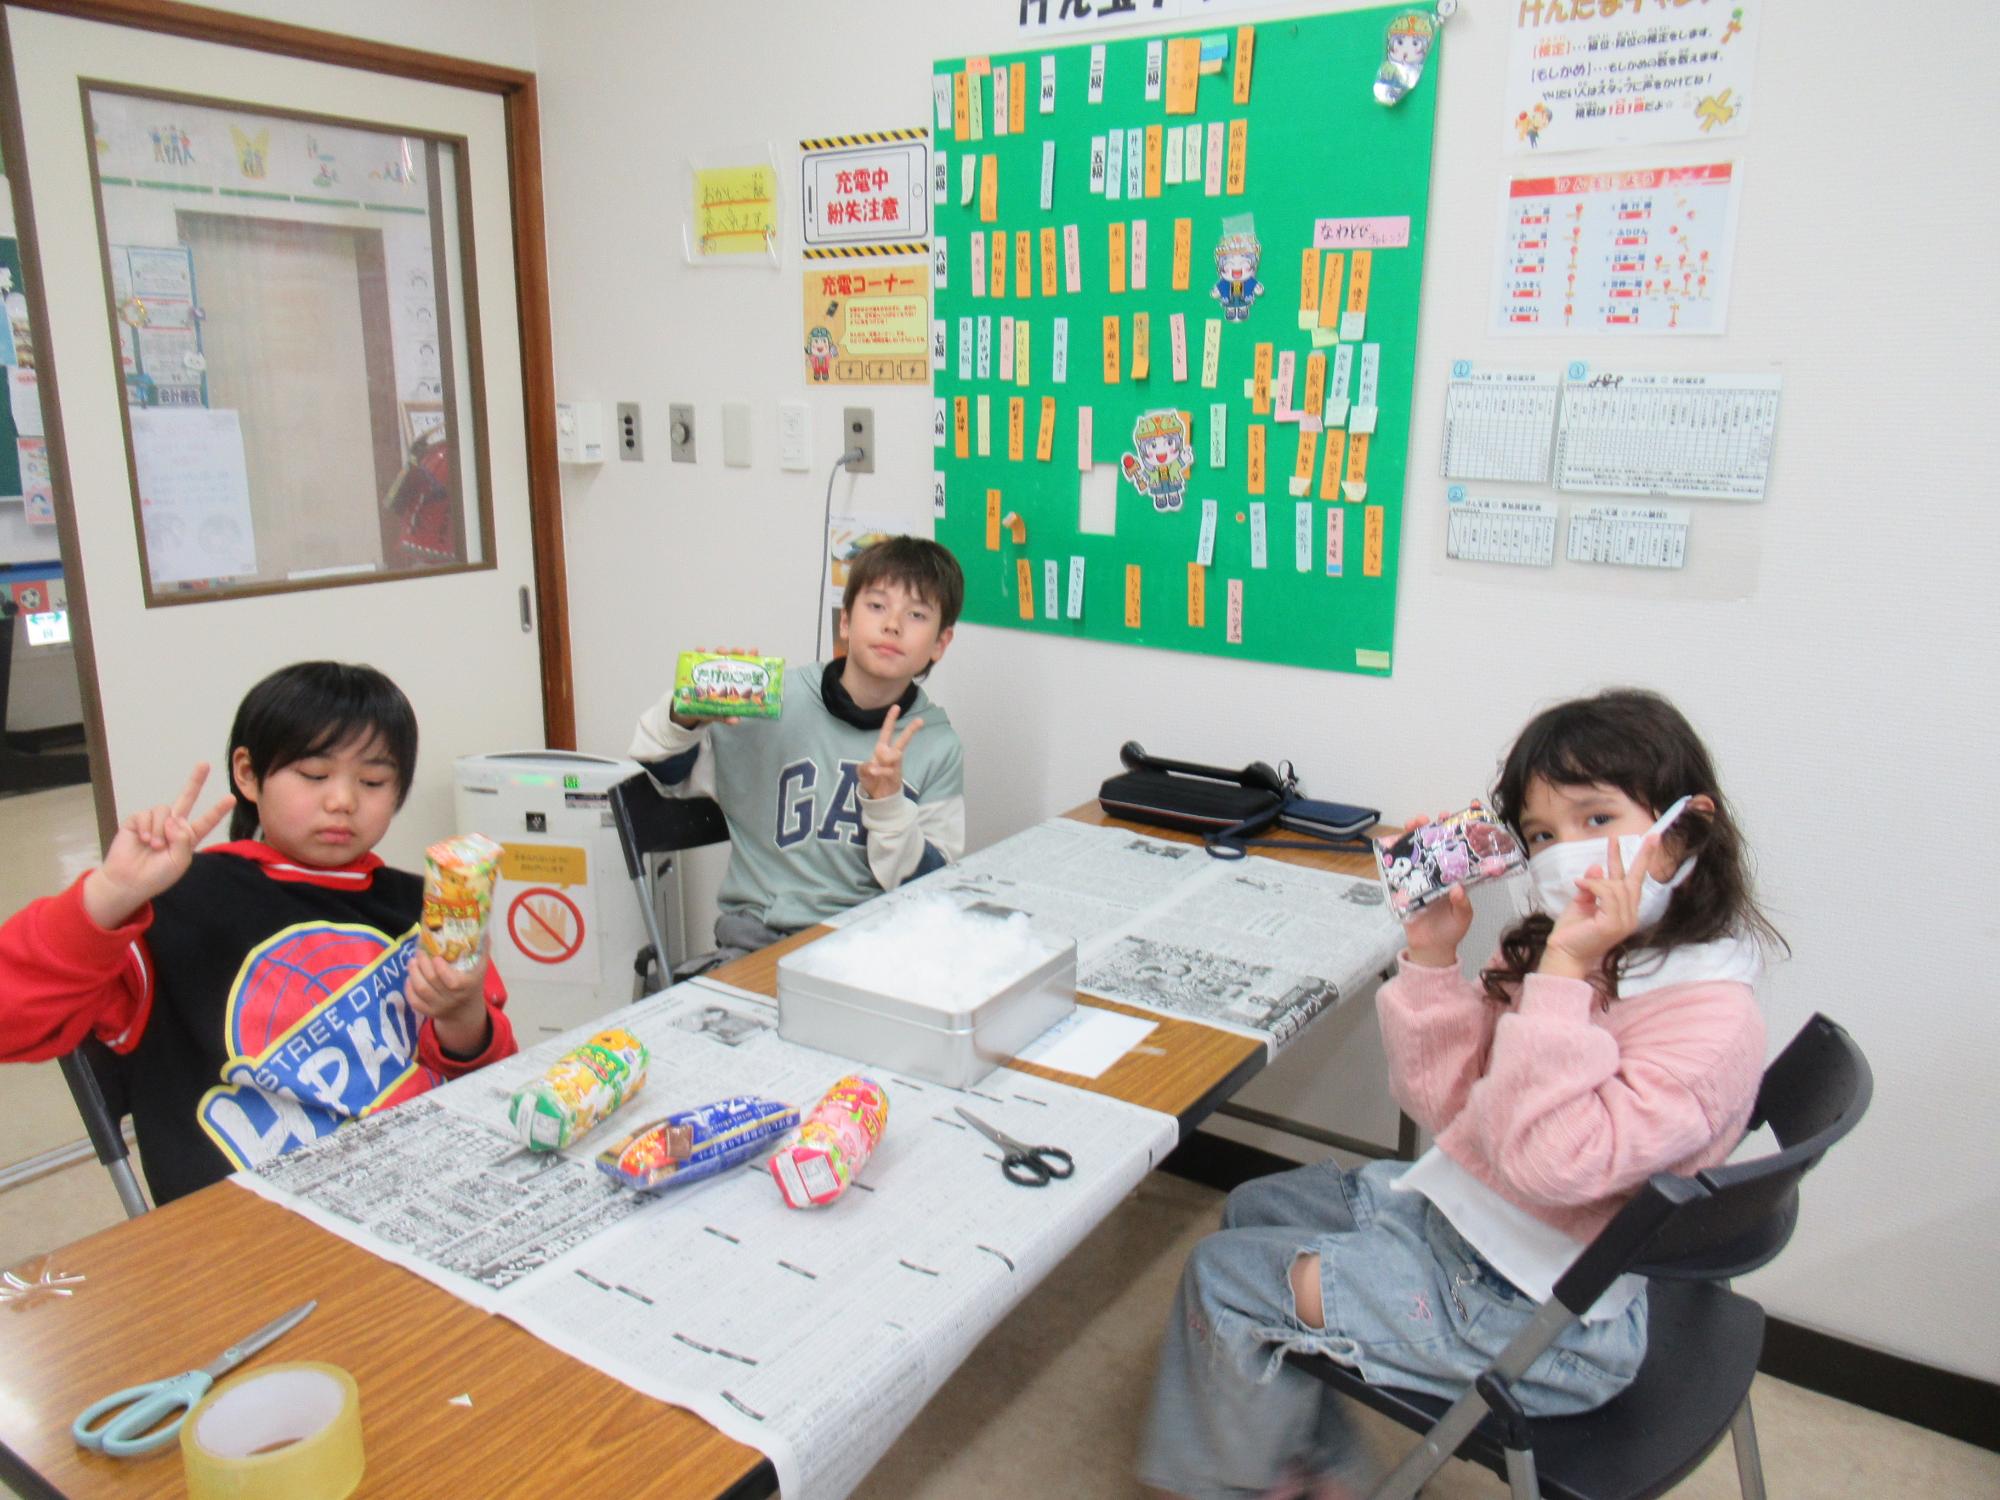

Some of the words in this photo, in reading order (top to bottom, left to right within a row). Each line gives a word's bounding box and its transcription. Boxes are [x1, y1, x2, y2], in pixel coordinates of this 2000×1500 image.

[835, 167, 889, 195] 充電中
[826, 197, 899, 225] 紛失注意
[822, 273, 914, 296] 充電コーナー
[775, 757, 905, 850] GA
